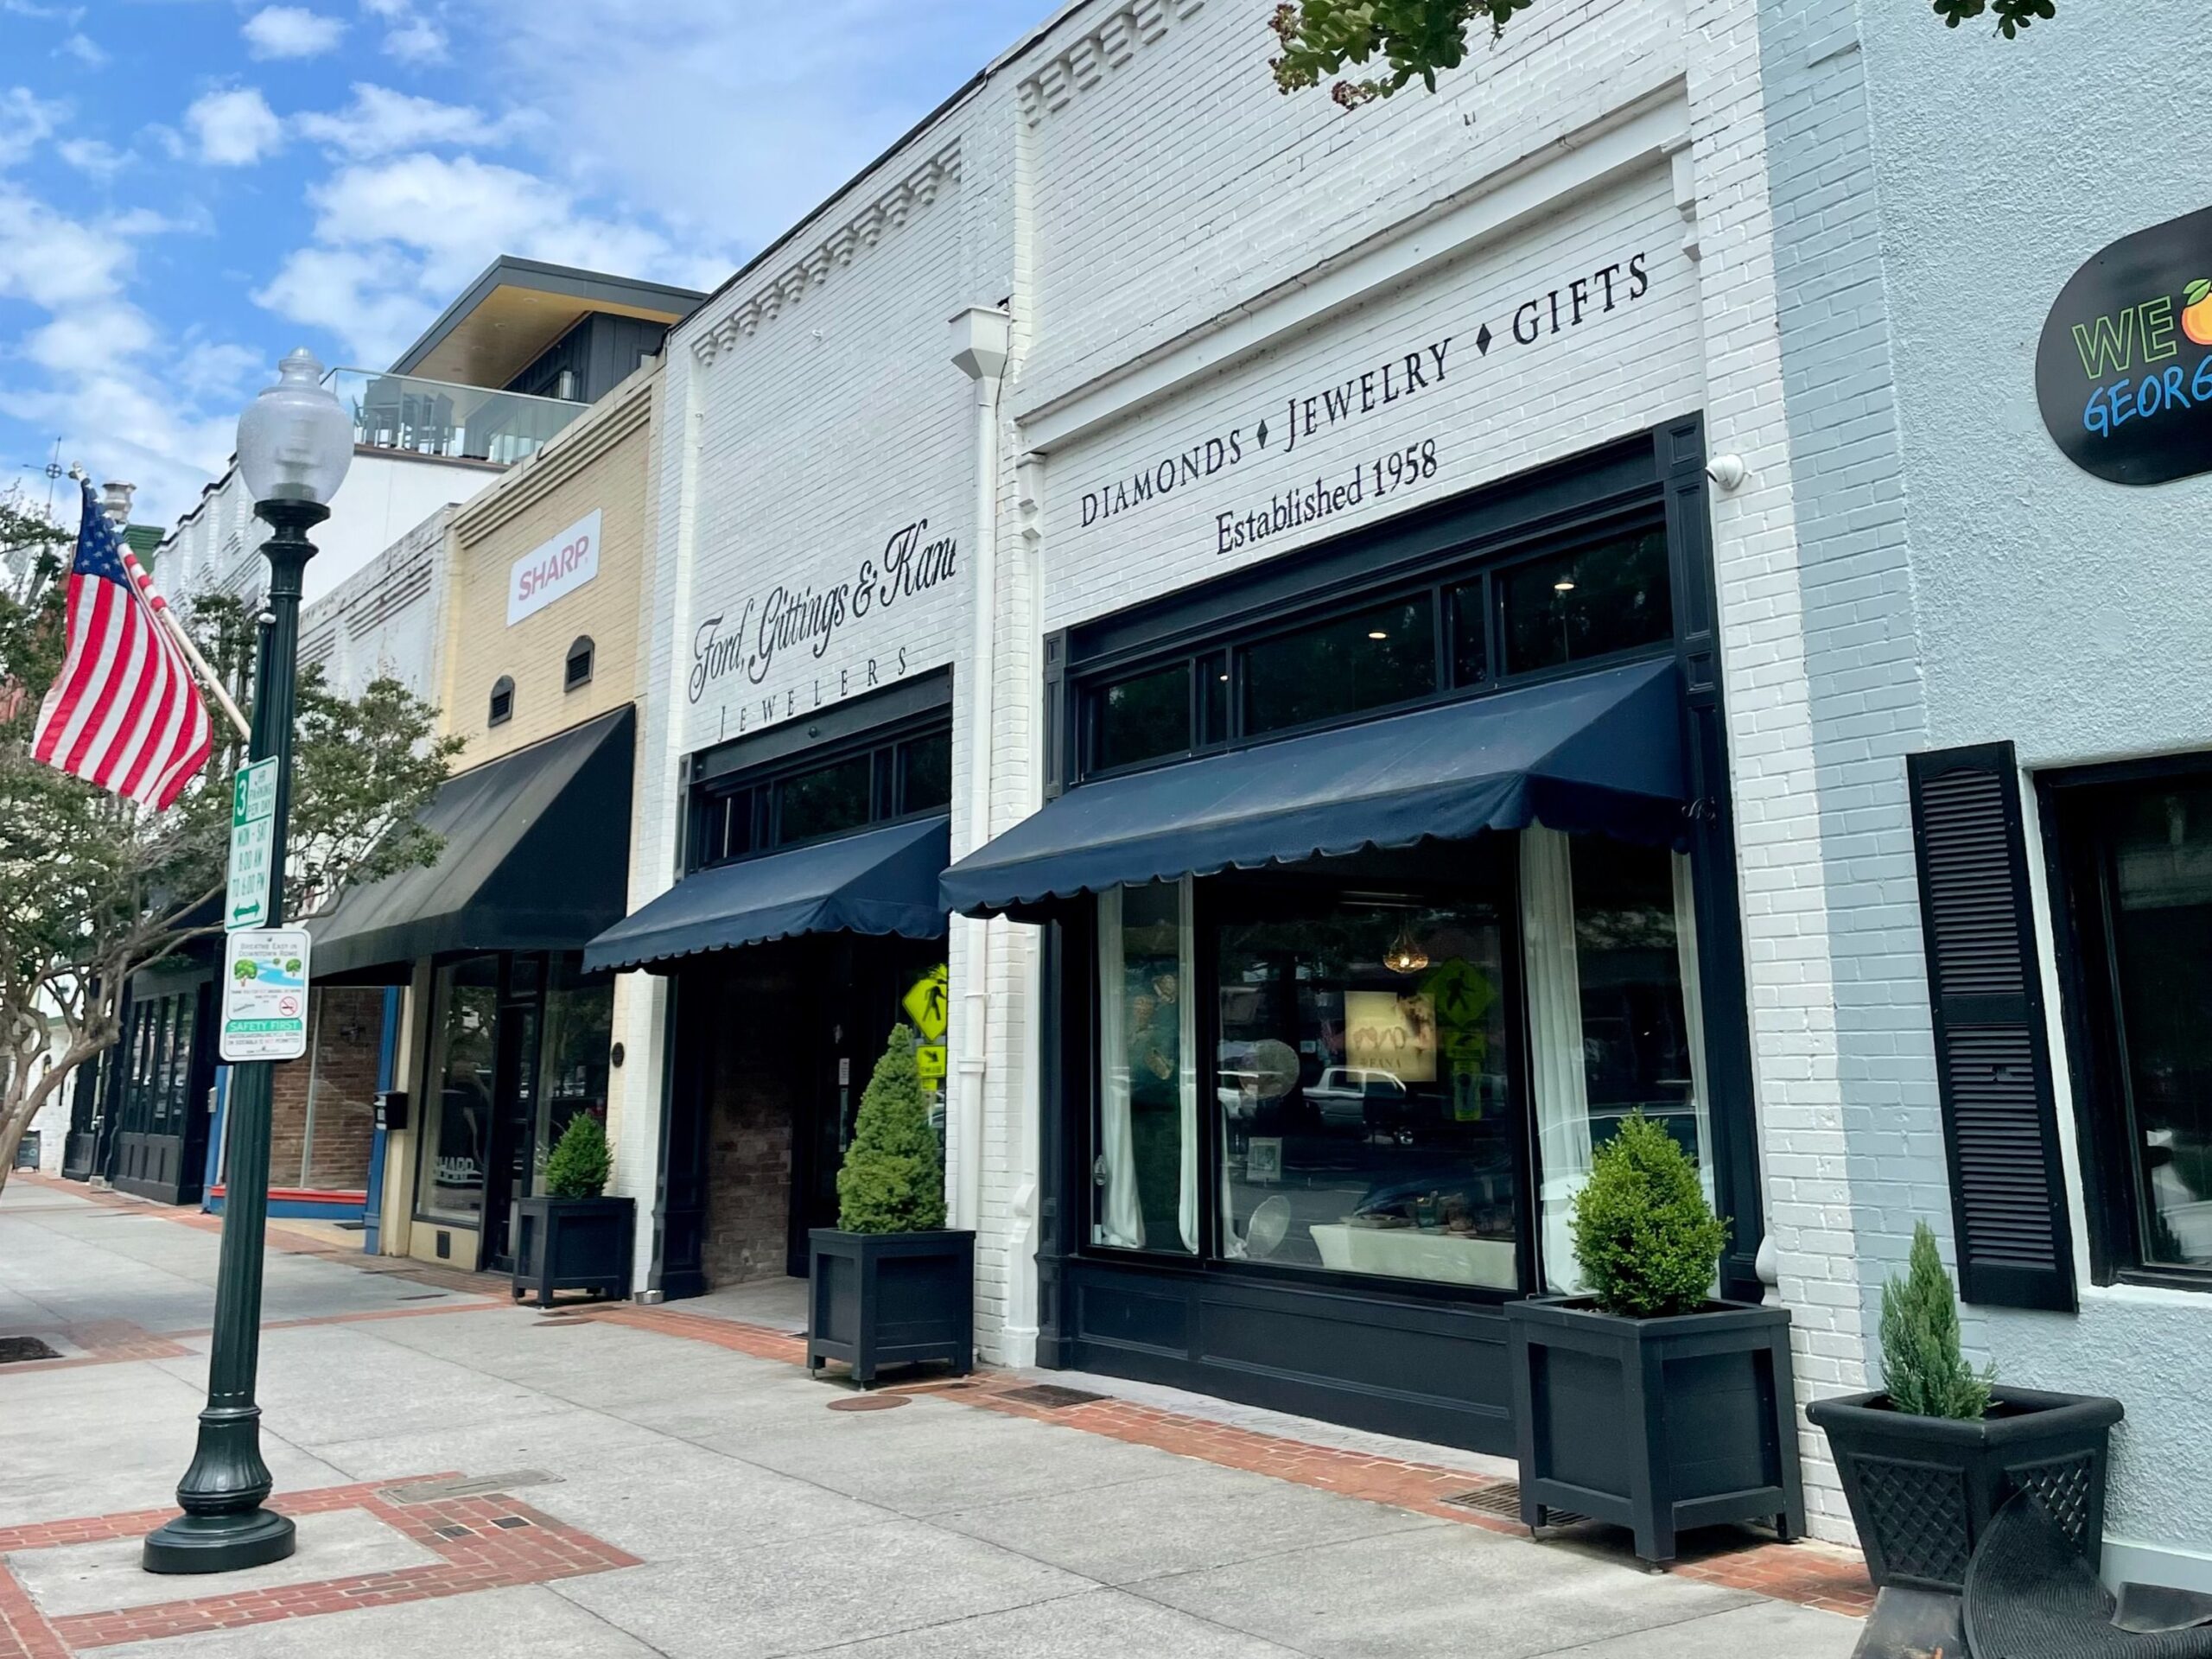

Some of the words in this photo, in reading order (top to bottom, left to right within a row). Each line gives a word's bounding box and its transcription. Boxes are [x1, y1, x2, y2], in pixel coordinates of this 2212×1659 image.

[2071, 295, 2177, 380] WE
[1080, 428, 1243, 528] DIAMONDS
[1283, 336, 1452, 453] JEWELRY
[1511, 251, 1649, 346] GIFTS
[1215, 463, 1363, 556] Established
[1372, 438, 1439, 498] 1958
[518, 535, 589, 601] SHARP
[688, 597, 754, 705] Ford,
[748, 585, 849, 685] Gittings
[853, 560, 877, 619] &
[717, 646, 906, 743] JEWELERS
[237, 779, 247, 817] 3
[248, 782, 273, 803] PARKING
[248, 802, 259, 817] PER
[261, 798, 271, 813] DAY
[238, 827, 251, 847] MON
[257, 821, 268, 843] SAT
[254, 848, 264, 868] AM
[256, 872, 265, 893] PM
[230, 1020, 267, 1032] SAFETY
[270, 1020, 298, 1031] FIRST
